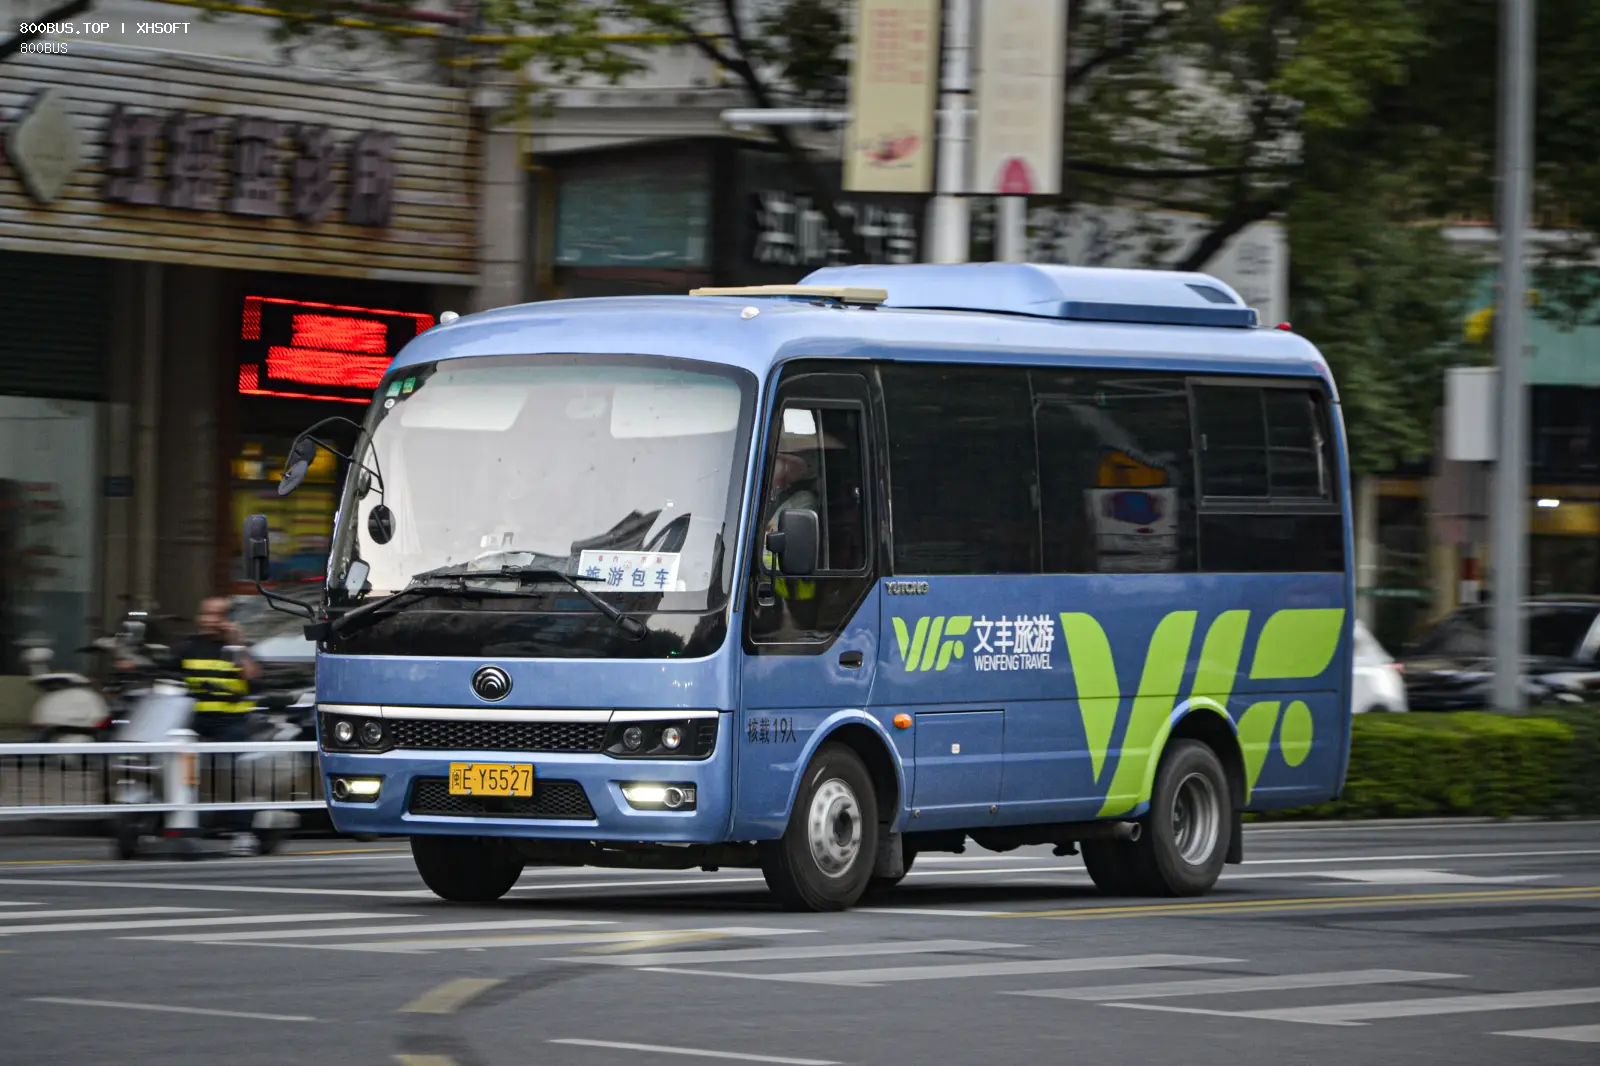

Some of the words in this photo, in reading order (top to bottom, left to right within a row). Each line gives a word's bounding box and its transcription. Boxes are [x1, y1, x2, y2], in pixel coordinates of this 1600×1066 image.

[585, 565, 669, 589] 旅游包车
[884, 581, 930, 596] YUTONG
[973, 614, 1055, 654] 文丰旅游
[974, 655, 1019, 671] WENFENG
[1020, 653, 1053, 670] TRAVEL
[748, 717, 797, 744] 核载19人
